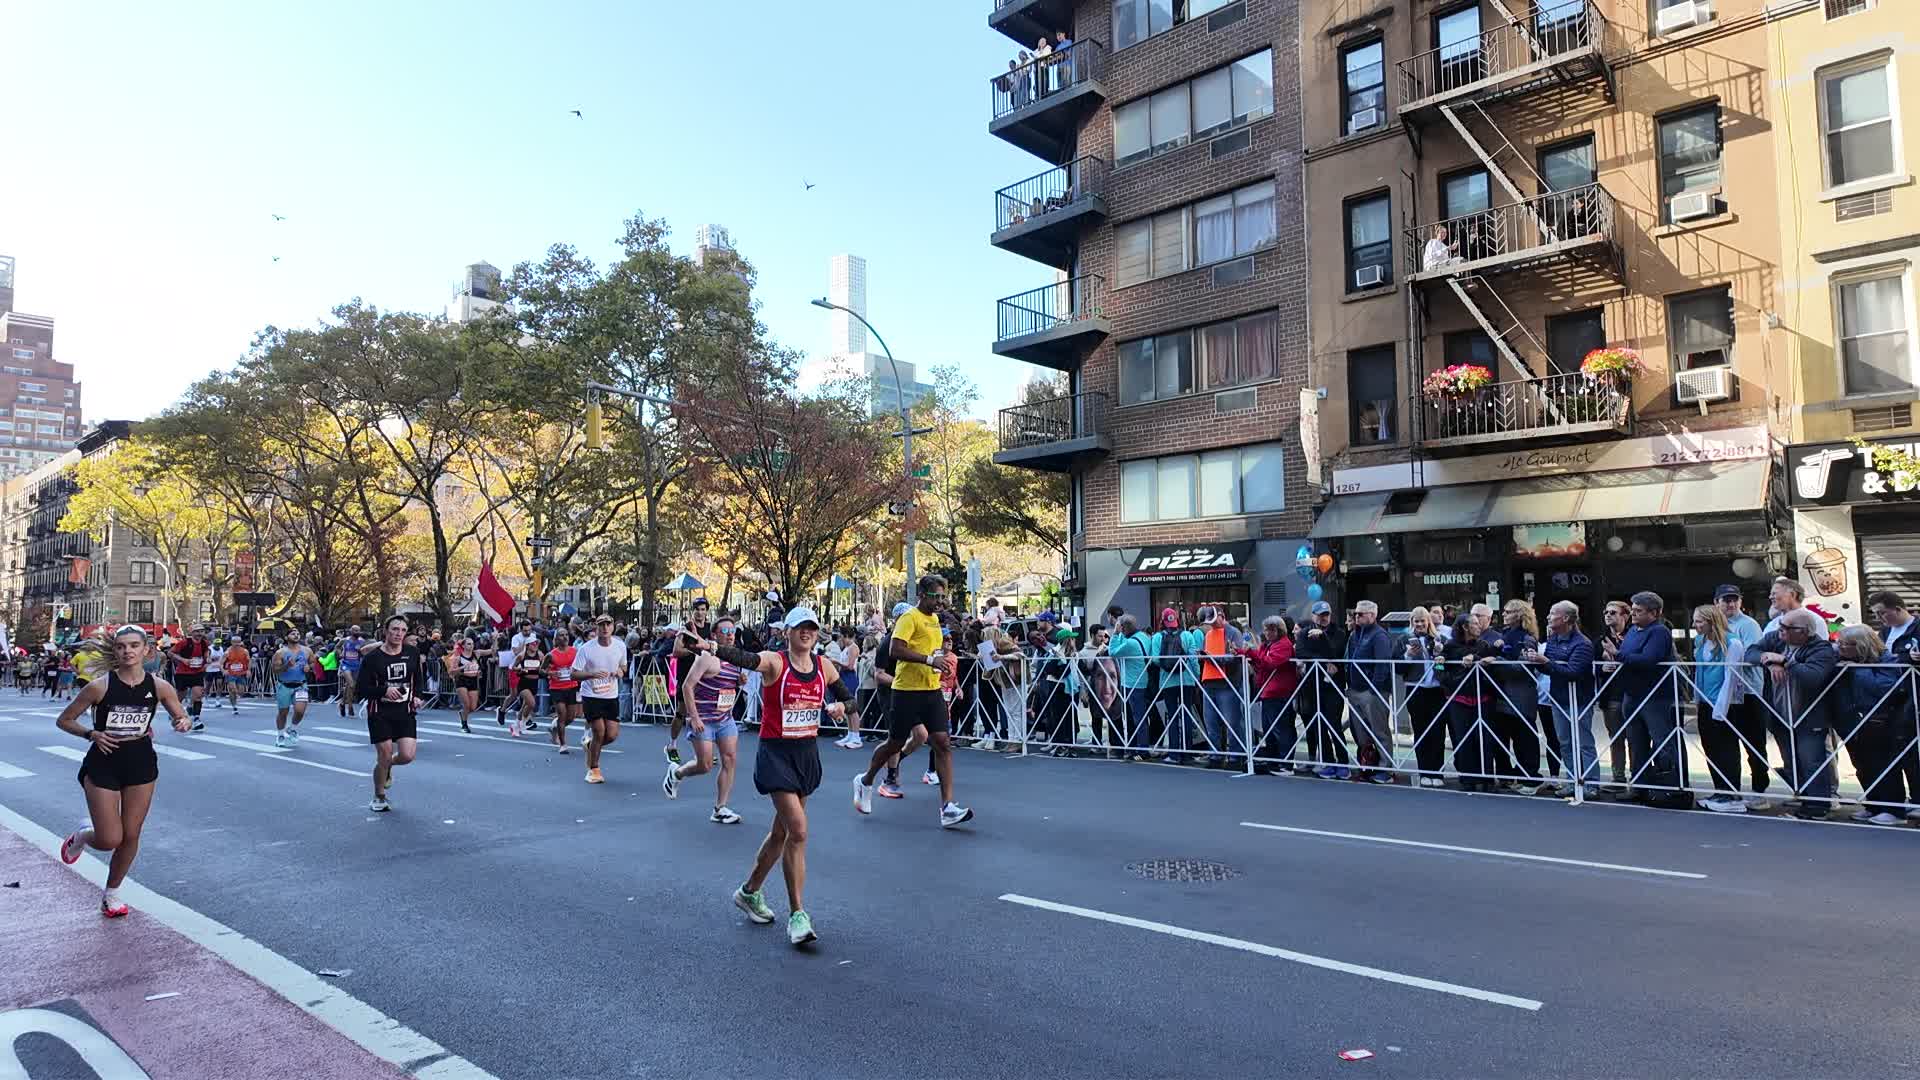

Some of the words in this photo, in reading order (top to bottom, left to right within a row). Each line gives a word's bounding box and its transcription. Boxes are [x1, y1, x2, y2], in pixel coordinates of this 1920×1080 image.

[1335, 482, 1361, 493] 1267
[1862, 471, 1888, 494] &
[1138, 553, 1235, 570] PIZZA
[1423, 573, 1474, 585] BREAKFAST
[110, 712, 148, 724] 21903
[786, 710, 819, 723] 27509
